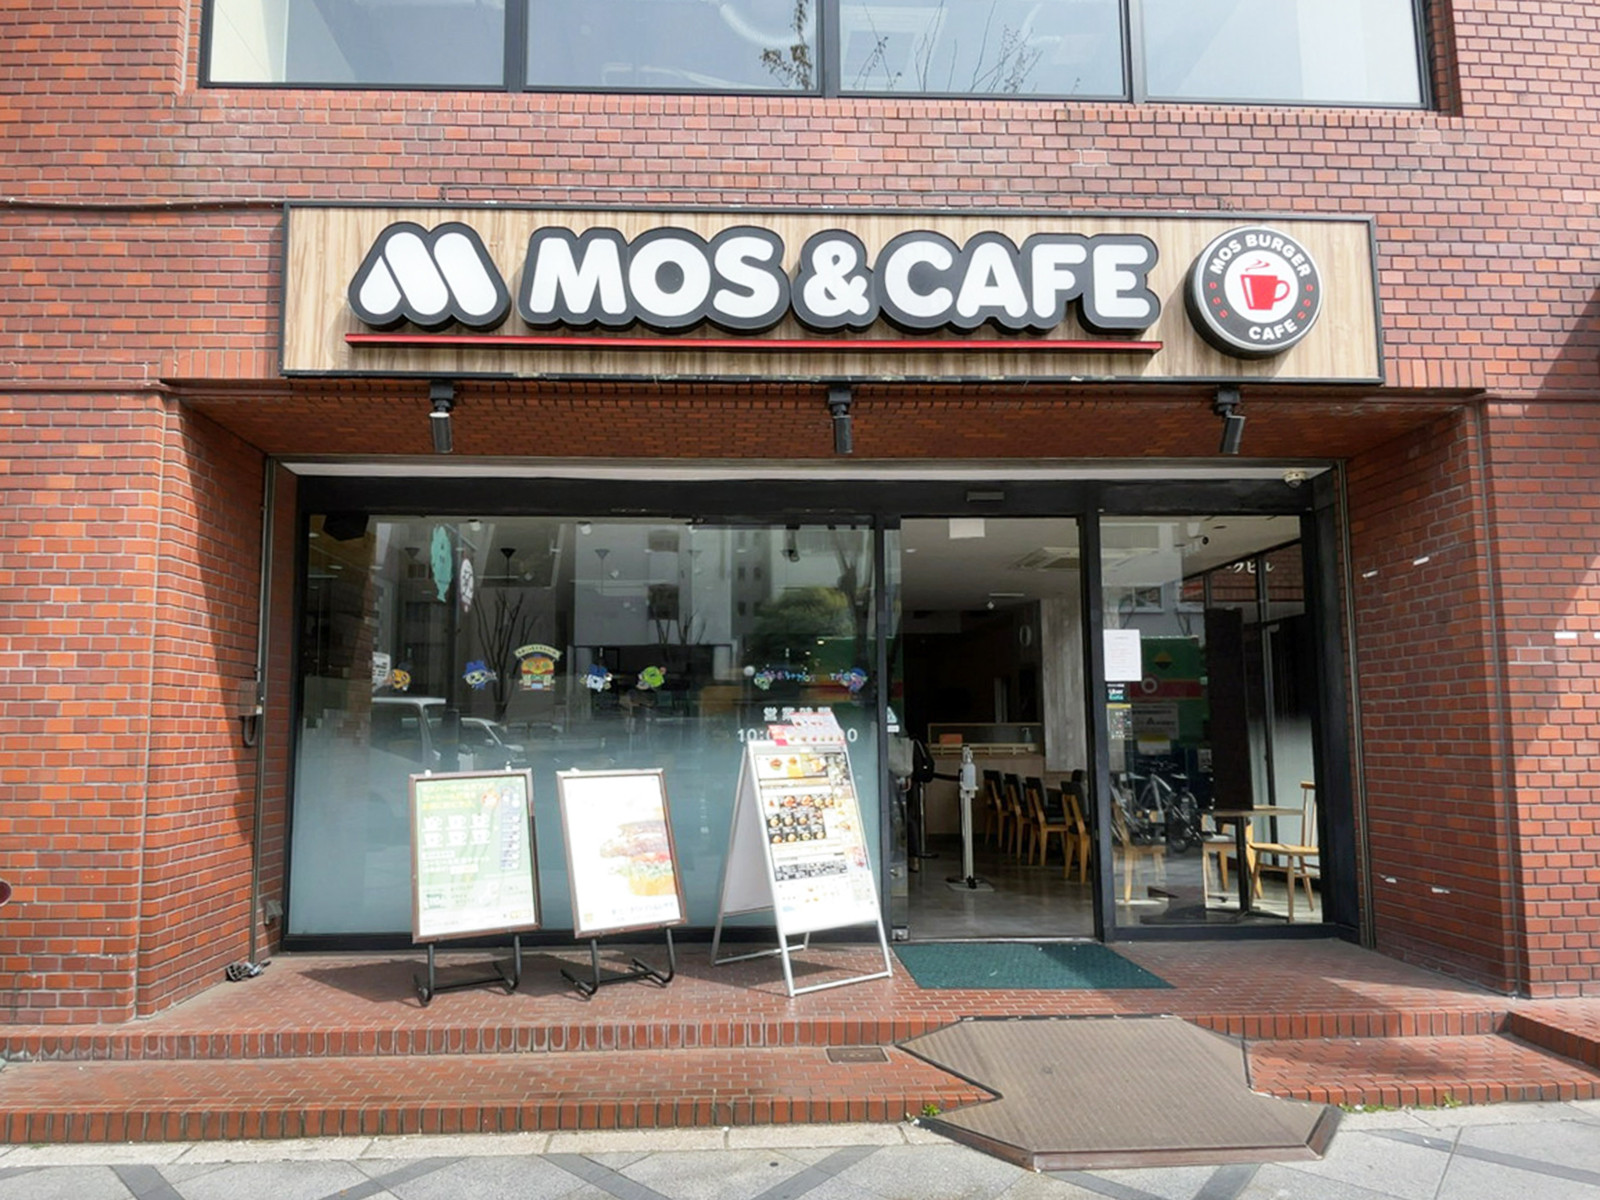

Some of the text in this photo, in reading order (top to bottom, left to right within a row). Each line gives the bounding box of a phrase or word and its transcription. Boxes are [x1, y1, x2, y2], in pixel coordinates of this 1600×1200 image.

[1209, 233, 1312, 277] MOS BURGER
[530, 236, 1151, 319] MOS & CAFE
[1249, 318, 1298, 340] CAFE
